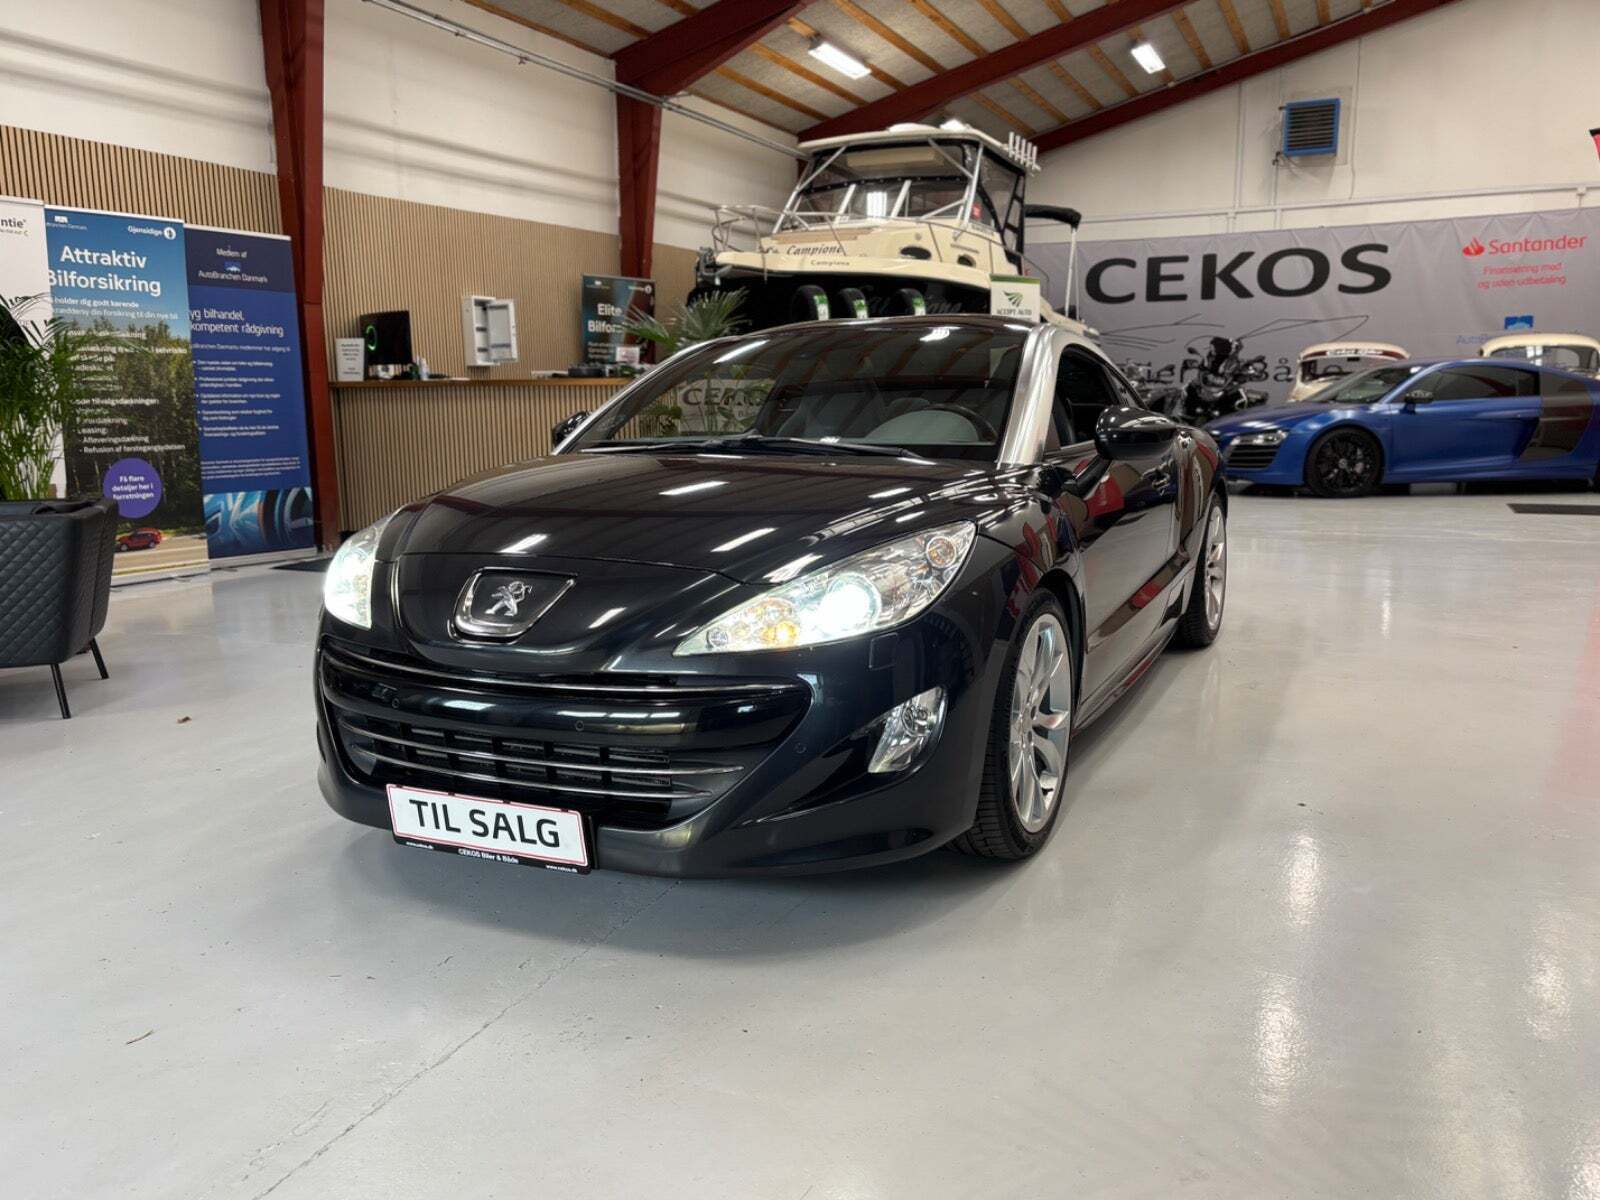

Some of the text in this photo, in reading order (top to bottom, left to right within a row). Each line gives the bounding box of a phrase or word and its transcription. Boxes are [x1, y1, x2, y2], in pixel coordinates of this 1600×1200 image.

[128, 225, 163, 237] Gjensidige
[216, 247, 240, 257] Medlem
[1488, 234, 1588, 255] Santander
[60, 245, 148, 269] Attraktiv
[48, 269, 161, 297] Bilforsikring
[1085, 243, 1392, 305] CEKOS
[597, 303, 622, 316] Elite
[241, 322, 284, 337] rådgivning
[409, 799, 560, 848] TIL SALG
[458, 848, 481, 858] CEKOS
